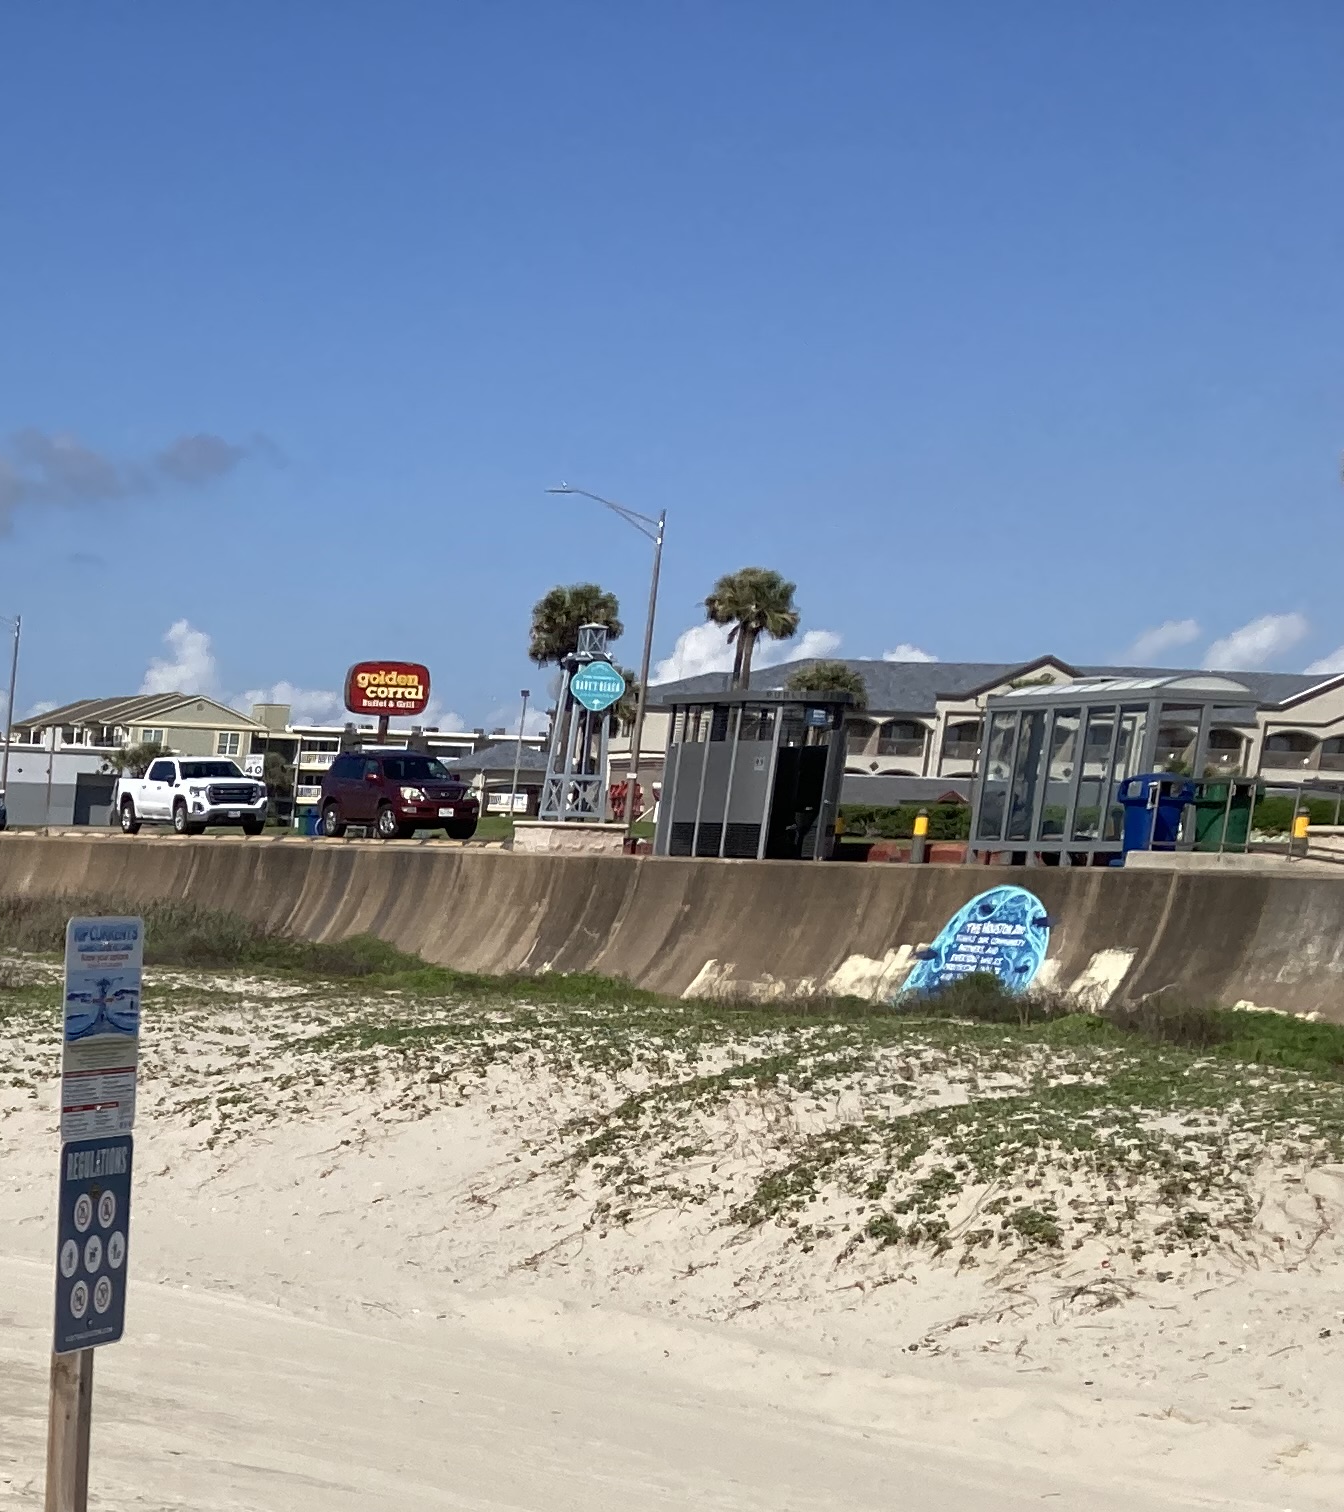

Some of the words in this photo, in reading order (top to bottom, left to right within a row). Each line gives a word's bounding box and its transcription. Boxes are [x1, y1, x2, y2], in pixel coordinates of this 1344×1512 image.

[356, 670, 419, 688] golden
[365, 685, 424, 699] corral
[362, 698, 387, 708] Buffet
[388, 700, 395, 708] &
[396, 700, 415, 709] Grill
[245, 766, 263, 775] 40
[66, 1146, 128, 1181] REGULATIONS
